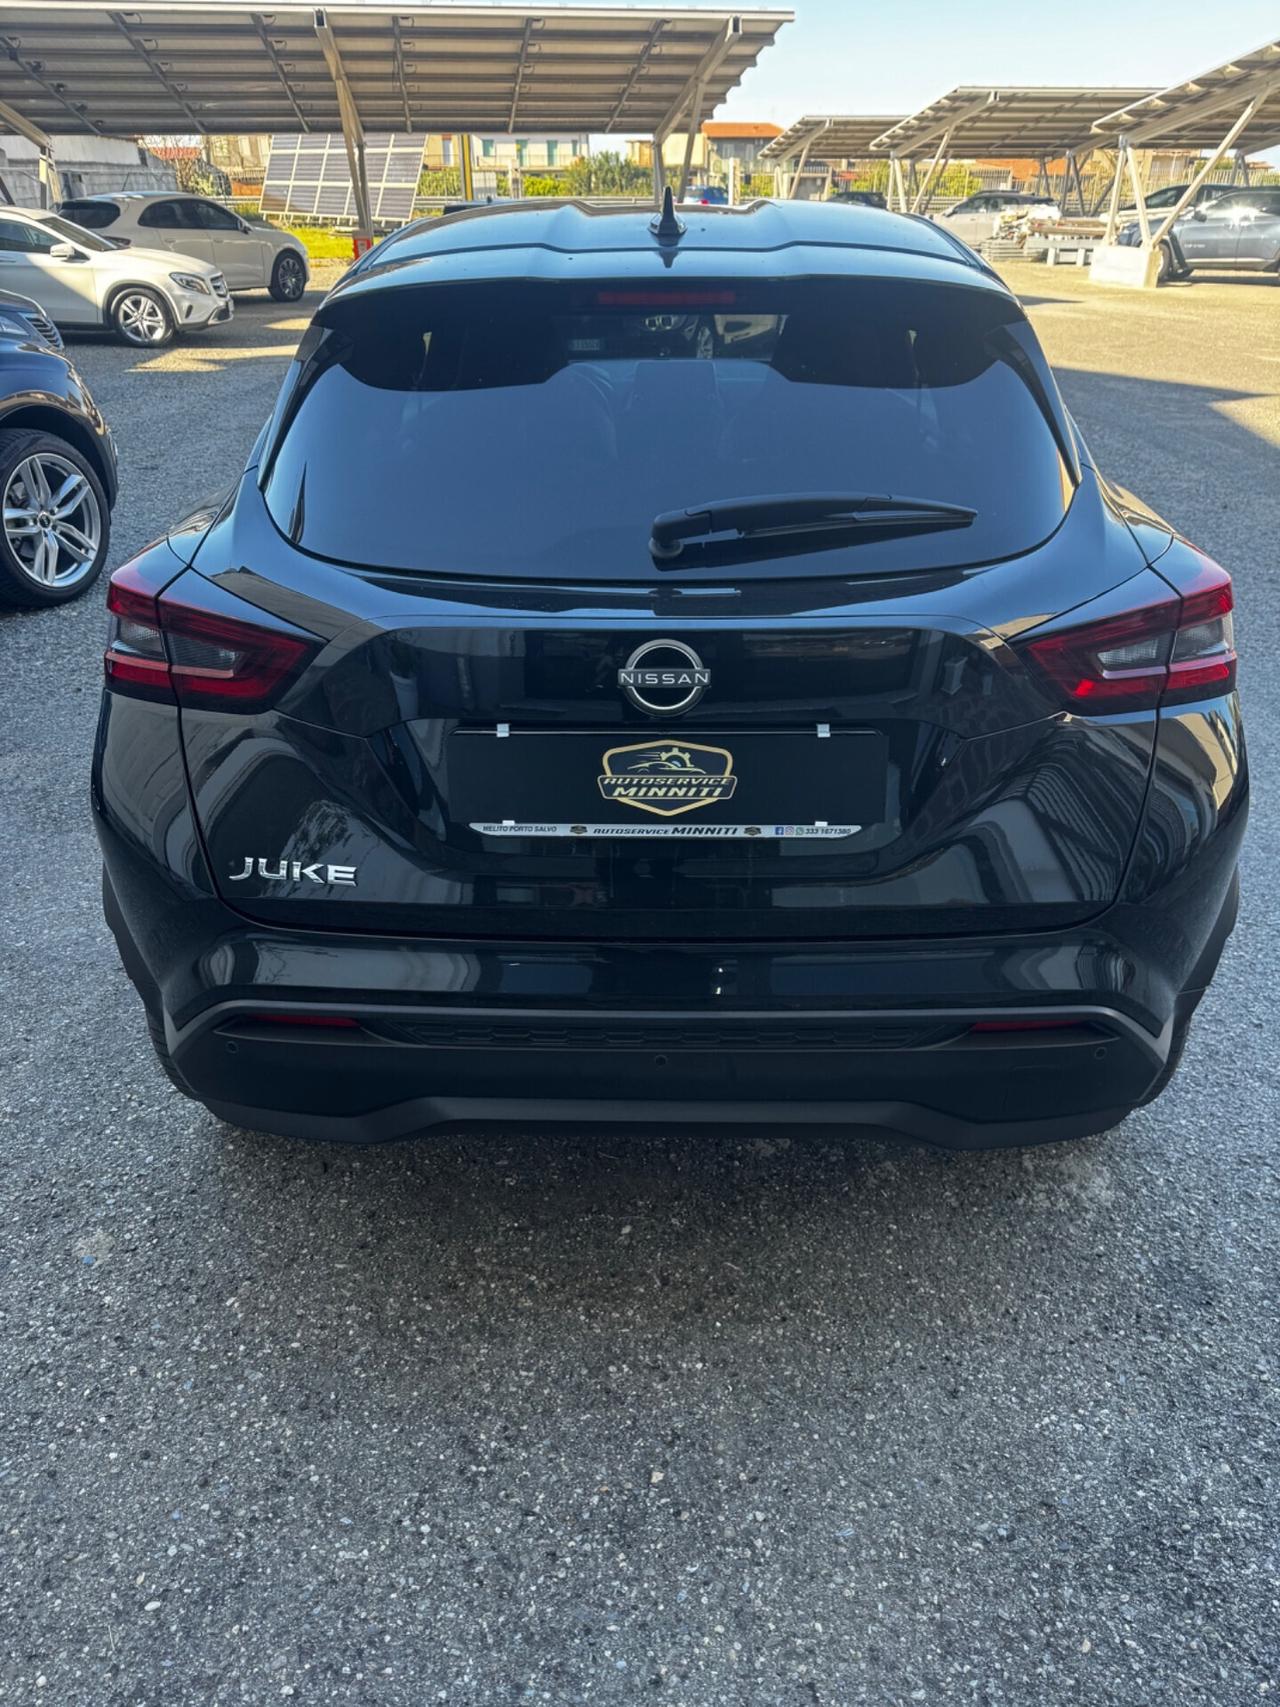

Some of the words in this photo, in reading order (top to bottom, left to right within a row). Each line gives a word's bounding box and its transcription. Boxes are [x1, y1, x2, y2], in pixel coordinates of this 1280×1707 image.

[620, 672, 709, 684] NISSAN
[612, 787, 723, 797] MINNITI
[671, 827, 738, 835] MINNITI
[229, 857, 357, 887] JUKE
